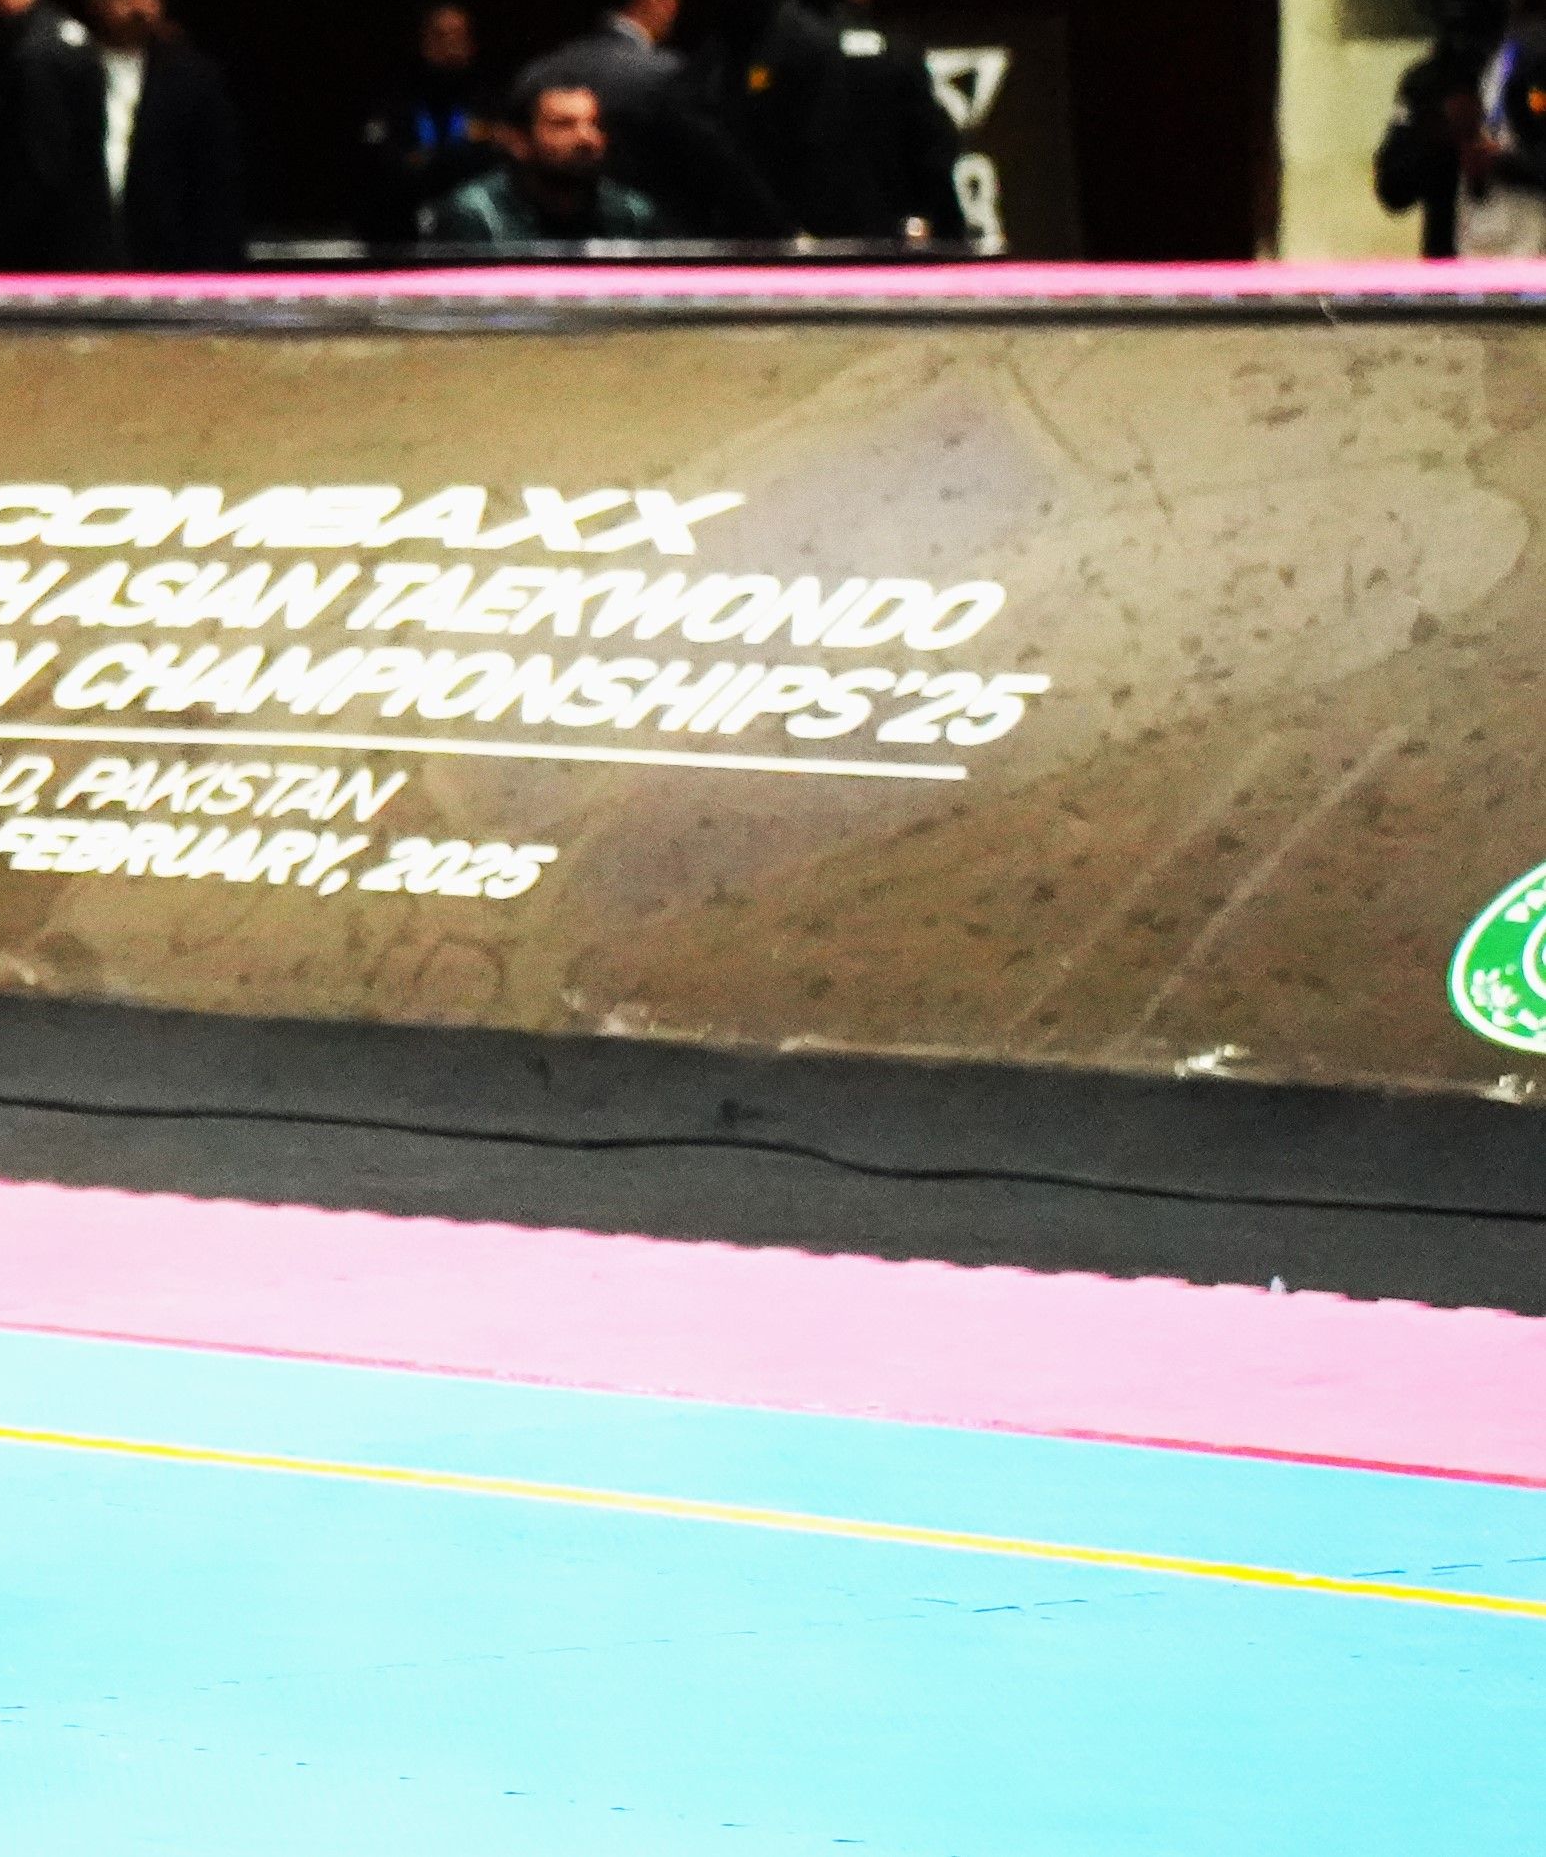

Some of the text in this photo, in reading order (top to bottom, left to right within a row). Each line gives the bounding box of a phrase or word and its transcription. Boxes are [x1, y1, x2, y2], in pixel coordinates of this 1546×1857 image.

[40, 561, 364, 632] ASIAN
[346, 561, 1007, 652] TAEKWONDO
[53, 641, 1052, 747] CHAMPIONSHIPS'25
[56, 755, 409, 825] PAKISTAN
[358, 836, 559, 901] 2025
